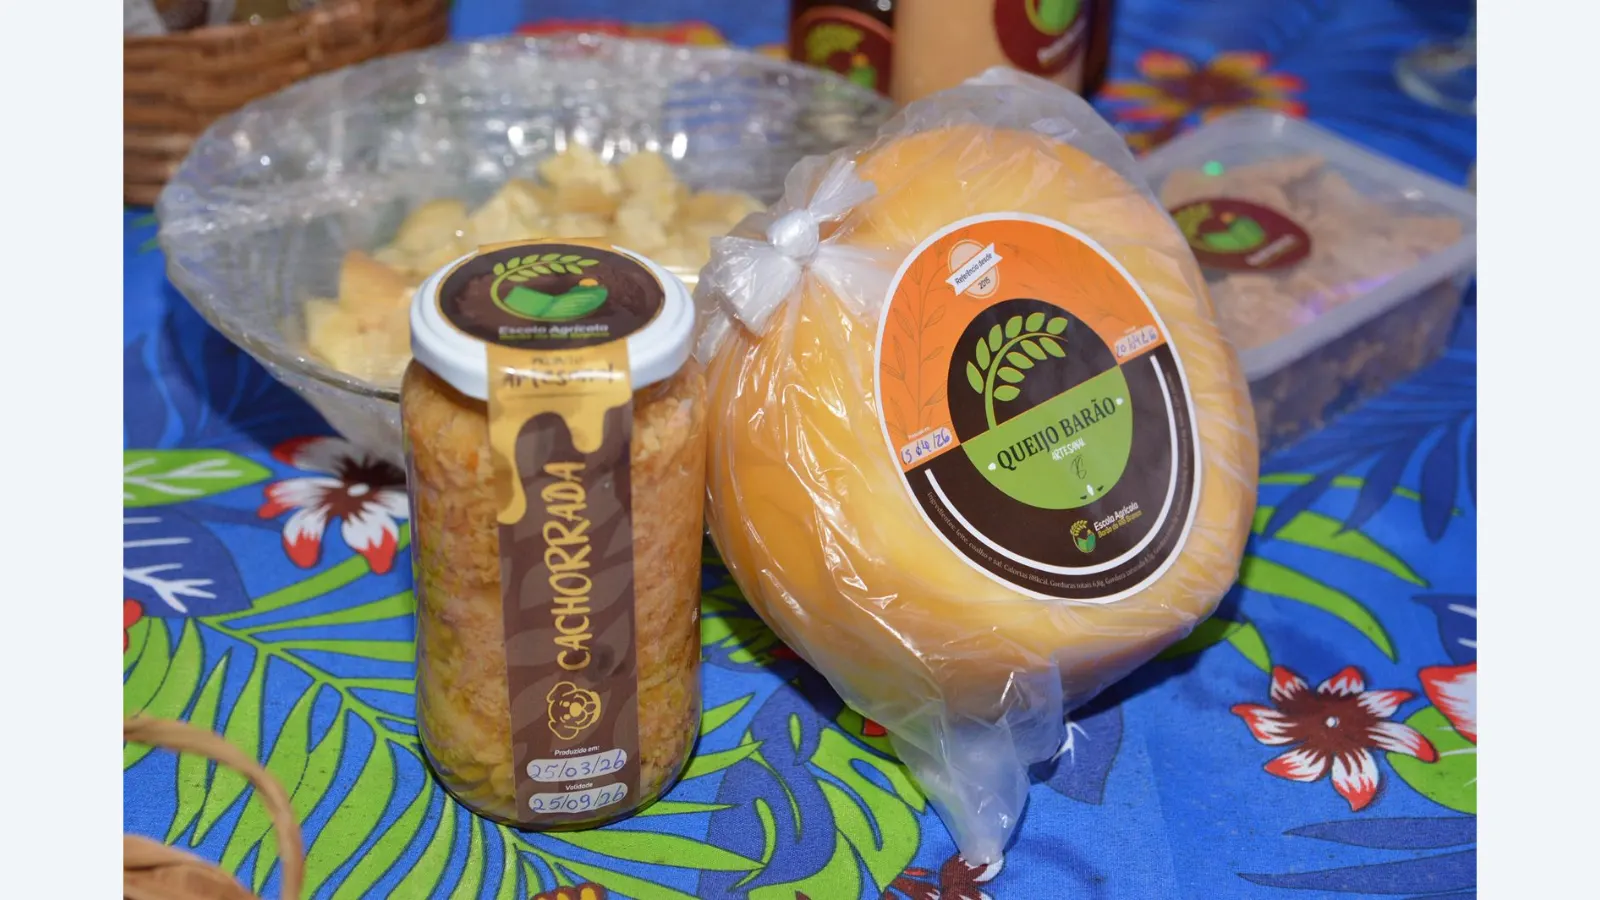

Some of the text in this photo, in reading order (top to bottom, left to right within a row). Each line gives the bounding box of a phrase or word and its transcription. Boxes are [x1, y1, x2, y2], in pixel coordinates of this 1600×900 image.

[997, 396, 1116, 471] QUEIJO BARÃO
[1094, 501, 1139, 532] Escola Agrícola
[541, 460, 593, 671] CACHORRADA
[530, 750, 625, 779] 25/03/26
[554, 748, 587, 756] Produzido
[532, 784, 624, 812] 25/09/26
[565, 783, 593, 791] Validade
